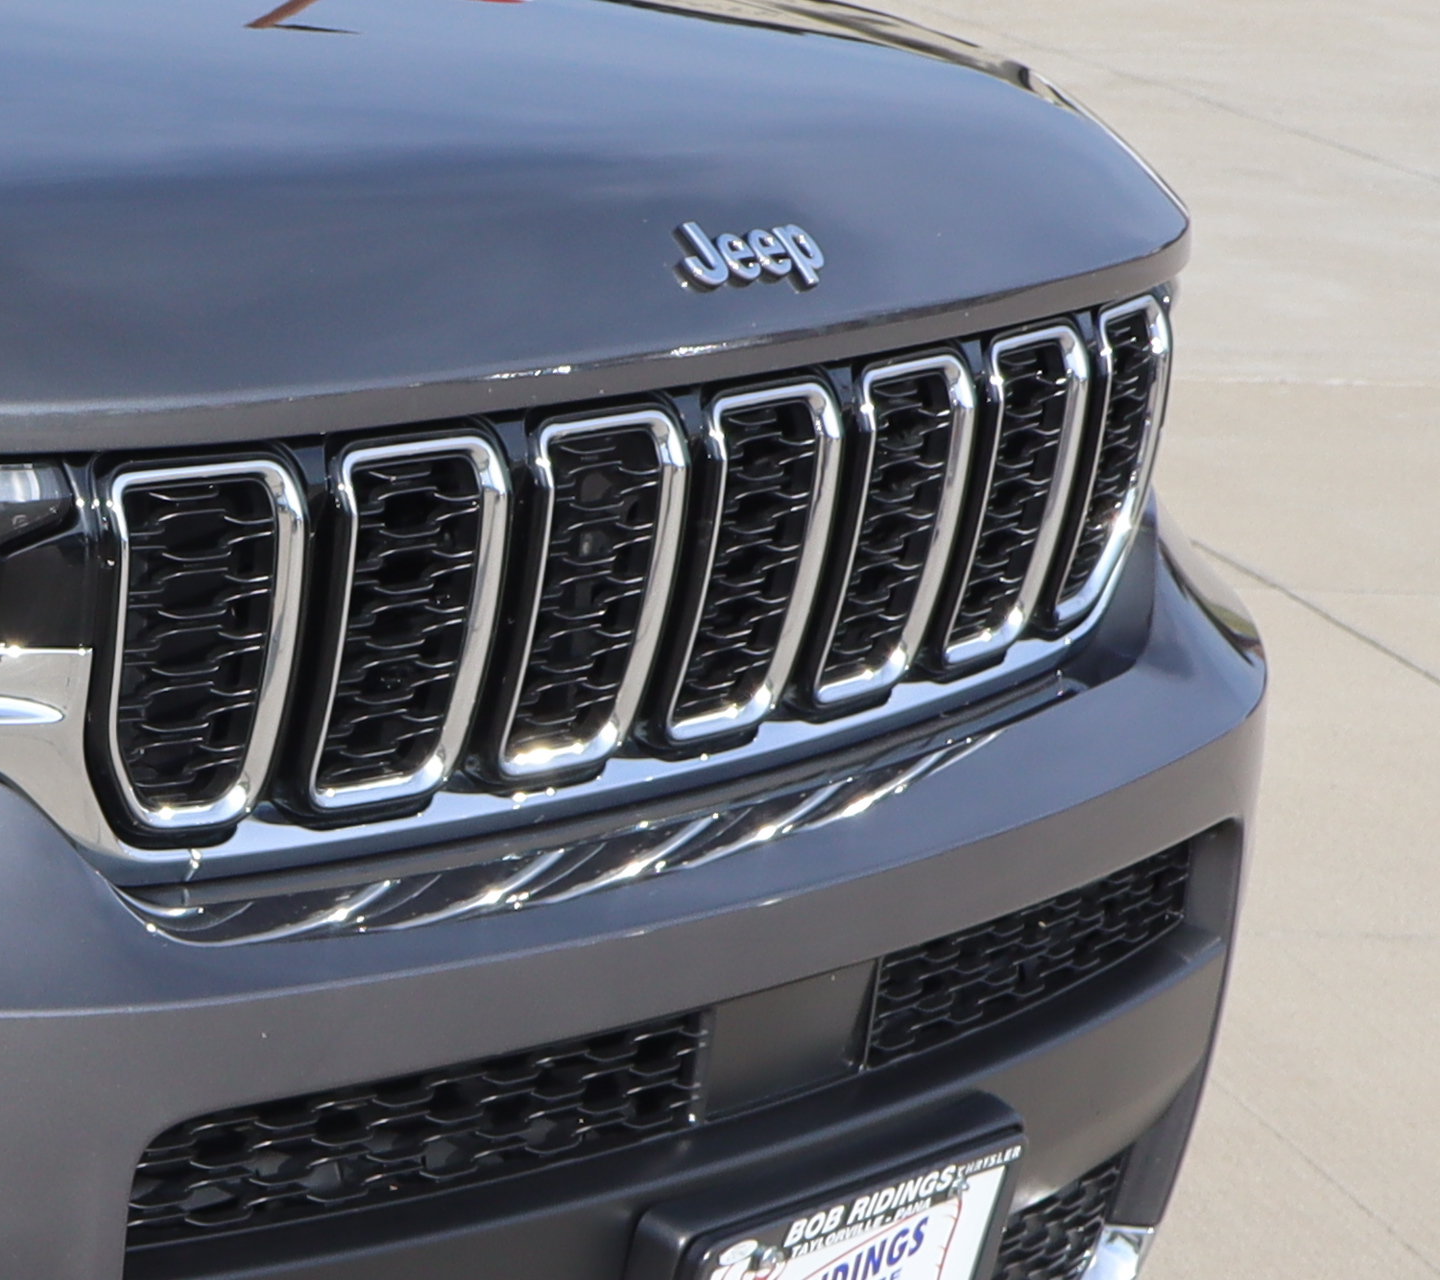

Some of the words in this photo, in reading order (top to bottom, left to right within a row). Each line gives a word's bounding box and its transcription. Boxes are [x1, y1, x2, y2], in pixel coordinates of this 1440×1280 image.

[679, 221, 825, 289] Jeep
[783, 1205, 845, 1248] BOB
[847, 1165, 957, 1223] RIDINGS
[789, 1214, 884, 1260] TAYLORVILLE
